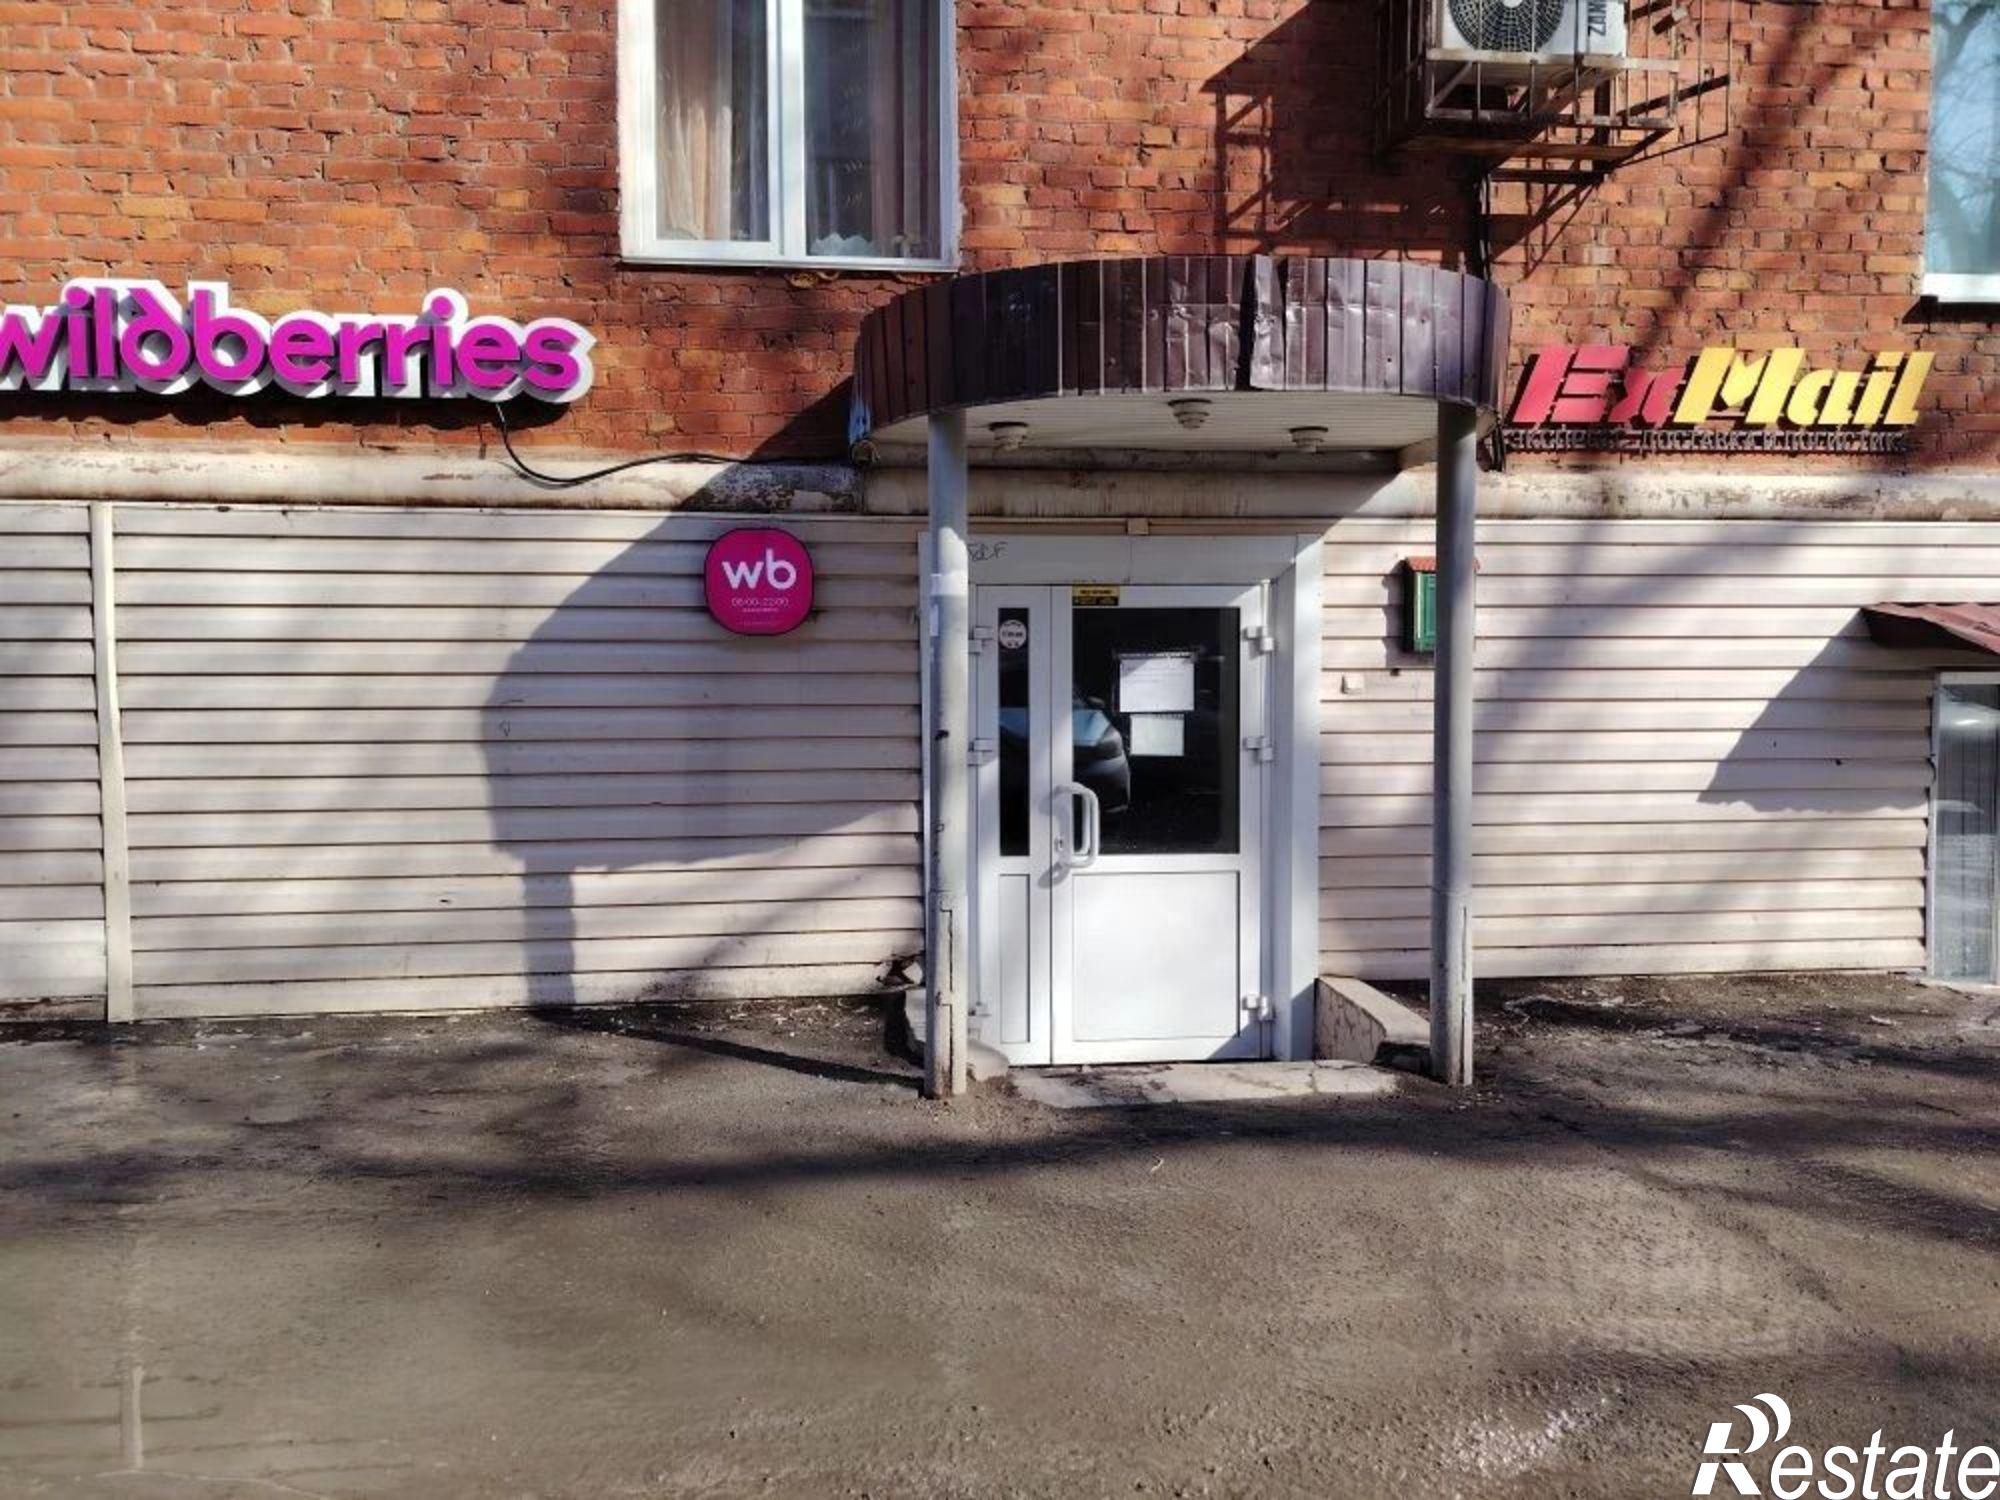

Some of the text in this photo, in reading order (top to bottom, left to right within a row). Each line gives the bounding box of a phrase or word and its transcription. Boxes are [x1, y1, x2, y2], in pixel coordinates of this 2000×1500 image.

[1587, 0, 1606, 36] ZAN
[0, 286, 590, 393] wildberries
[721, 548, 797, 590] wb
